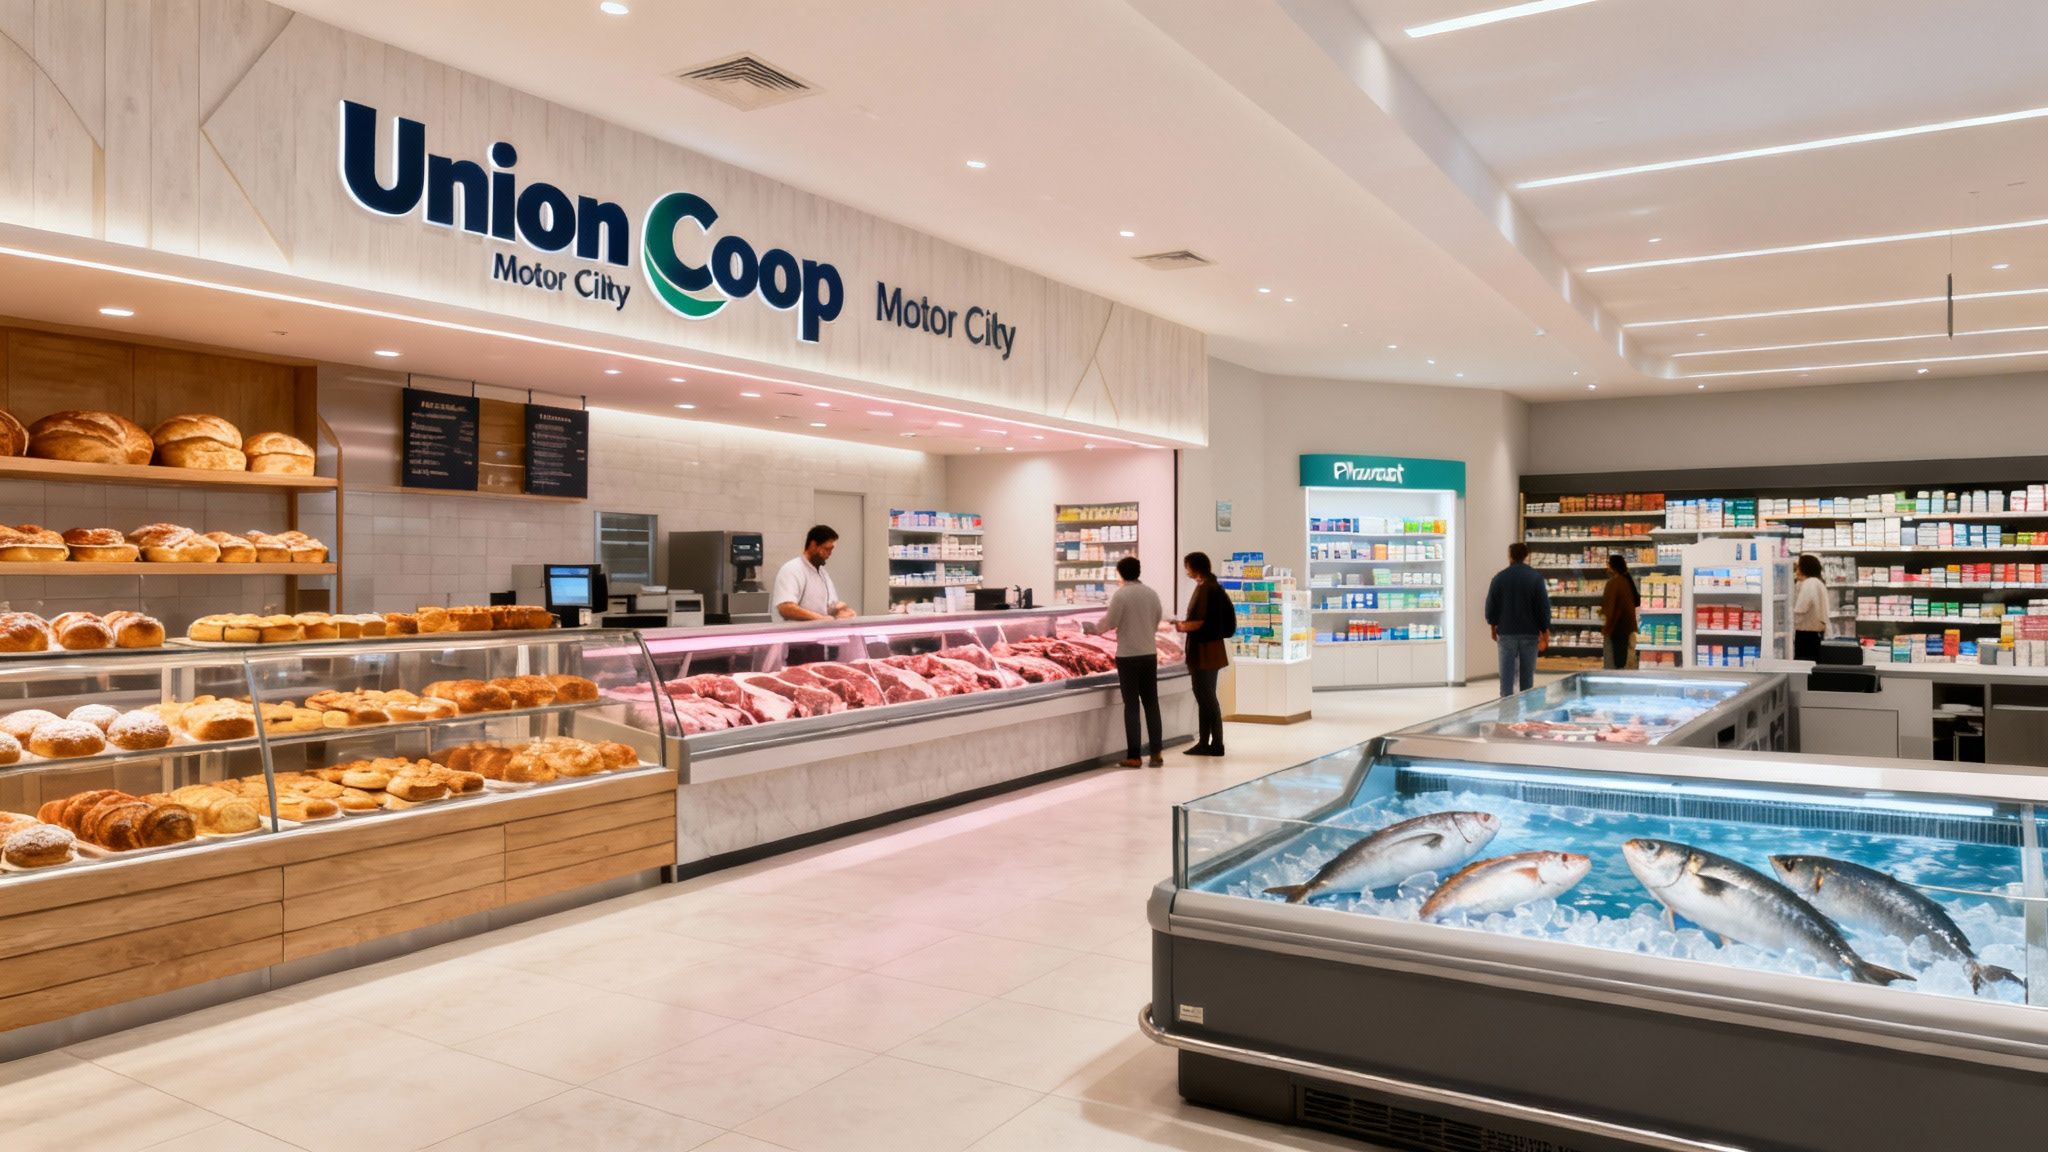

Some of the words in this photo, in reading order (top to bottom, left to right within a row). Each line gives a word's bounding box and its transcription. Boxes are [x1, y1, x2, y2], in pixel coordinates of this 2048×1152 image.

[341, 100, 629, 266] Union
[642, 191, 844, 343] Coop
[493, 252, 567, 291] Motor
[876, 281, 958, 338] Motor
[964, 305, 1016, 361] City
